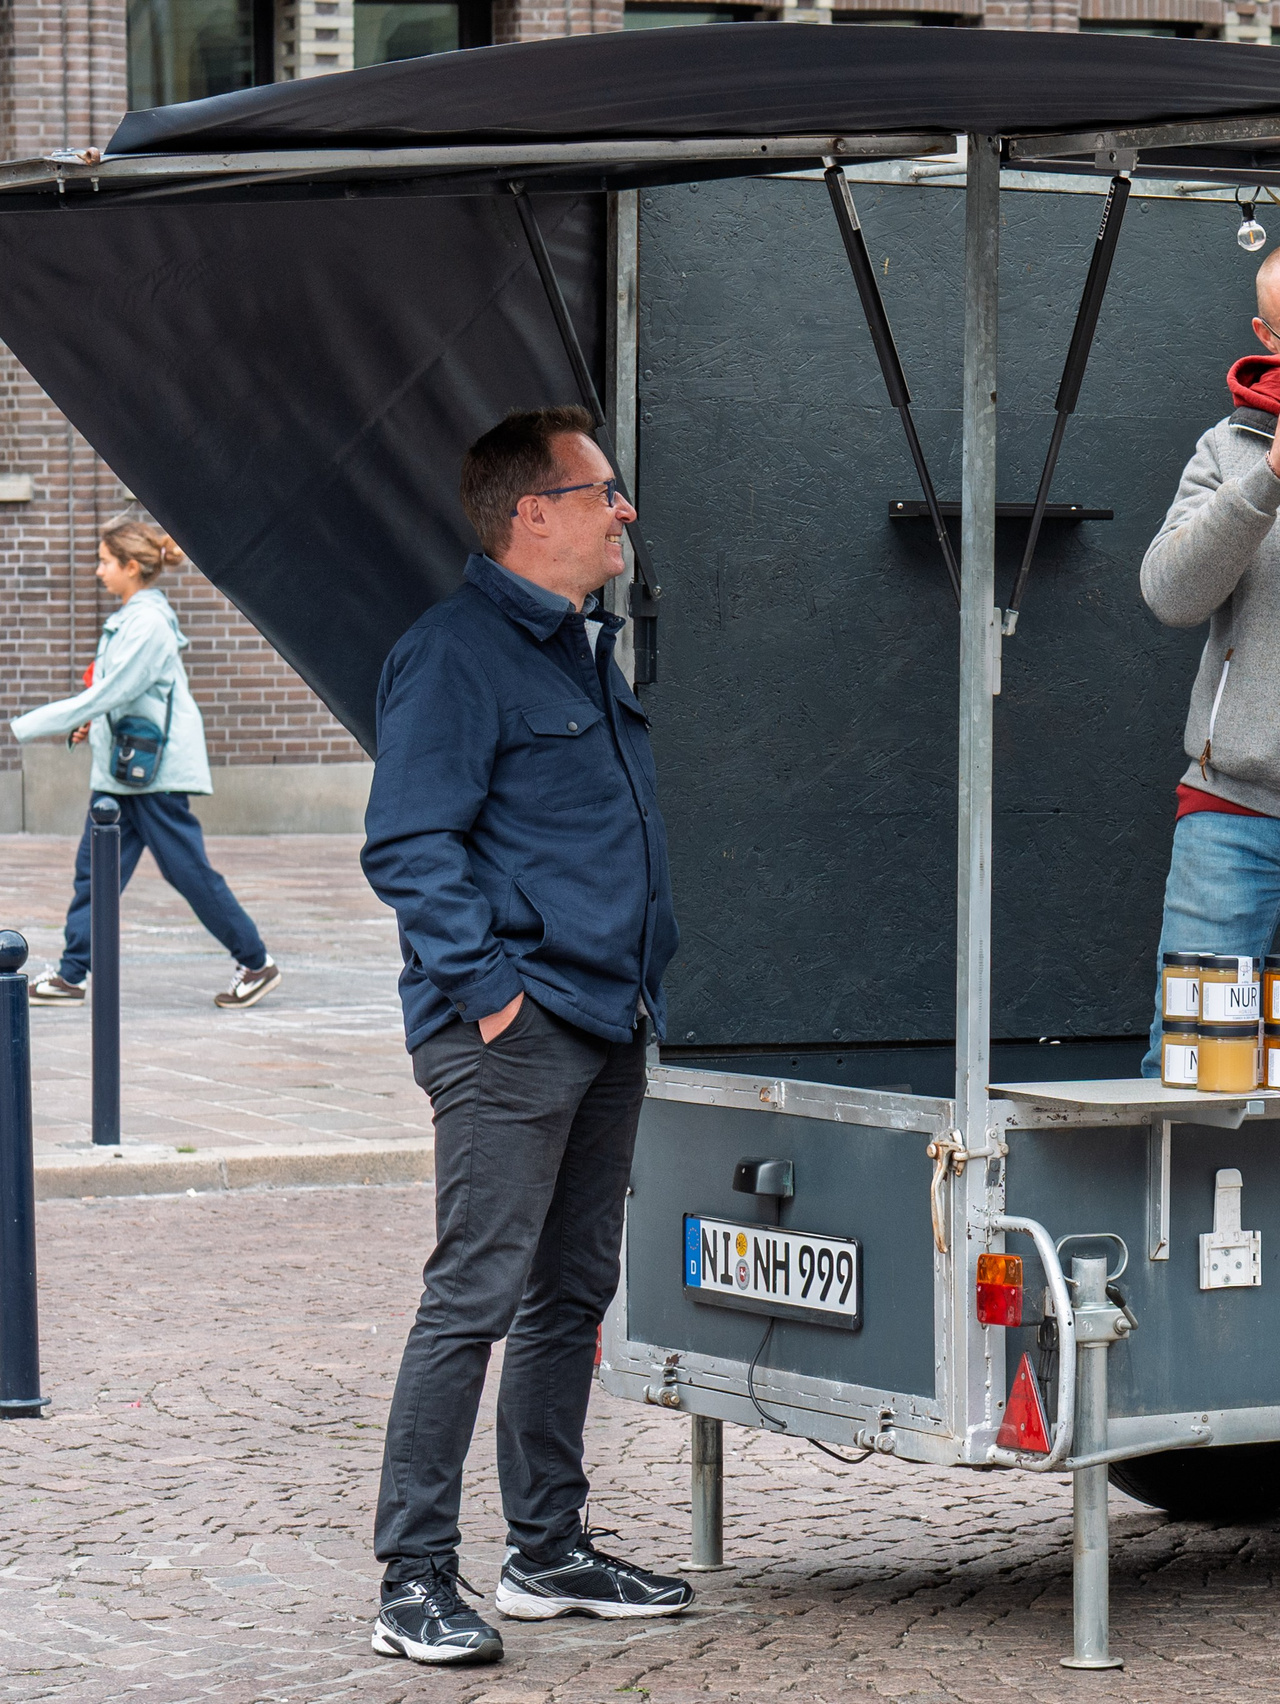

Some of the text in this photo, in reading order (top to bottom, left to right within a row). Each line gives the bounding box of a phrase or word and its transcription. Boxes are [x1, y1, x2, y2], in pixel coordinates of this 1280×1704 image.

[1230, 987, 1257, 1008] NUR
[690, 1260, 697, 1275] D
[702, 1227, 853, 1305] NI NH 999
